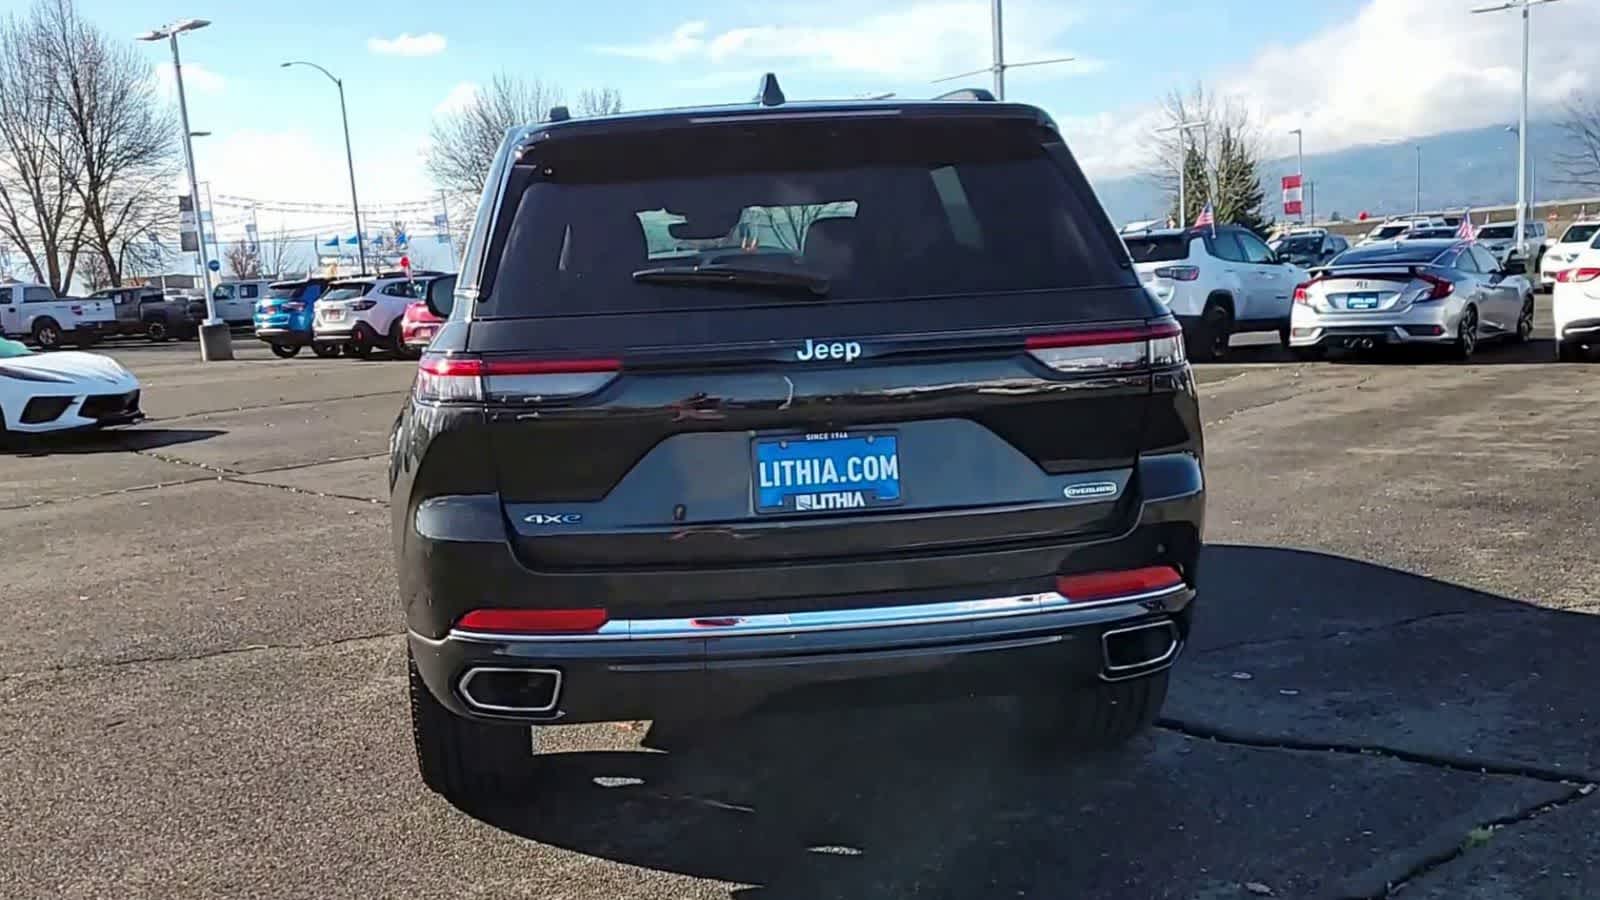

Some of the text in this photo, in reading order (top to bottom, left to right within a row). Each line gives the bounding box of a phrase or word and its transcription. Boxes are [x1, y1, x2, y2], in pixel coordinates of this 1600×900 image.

[797, 339, 861, 362] Jeep
[805, 432, 829, 440] SINCE
[759, 454, 899, 487] LITHIA.COM
[812, 491, 865, 510] LITHIA
